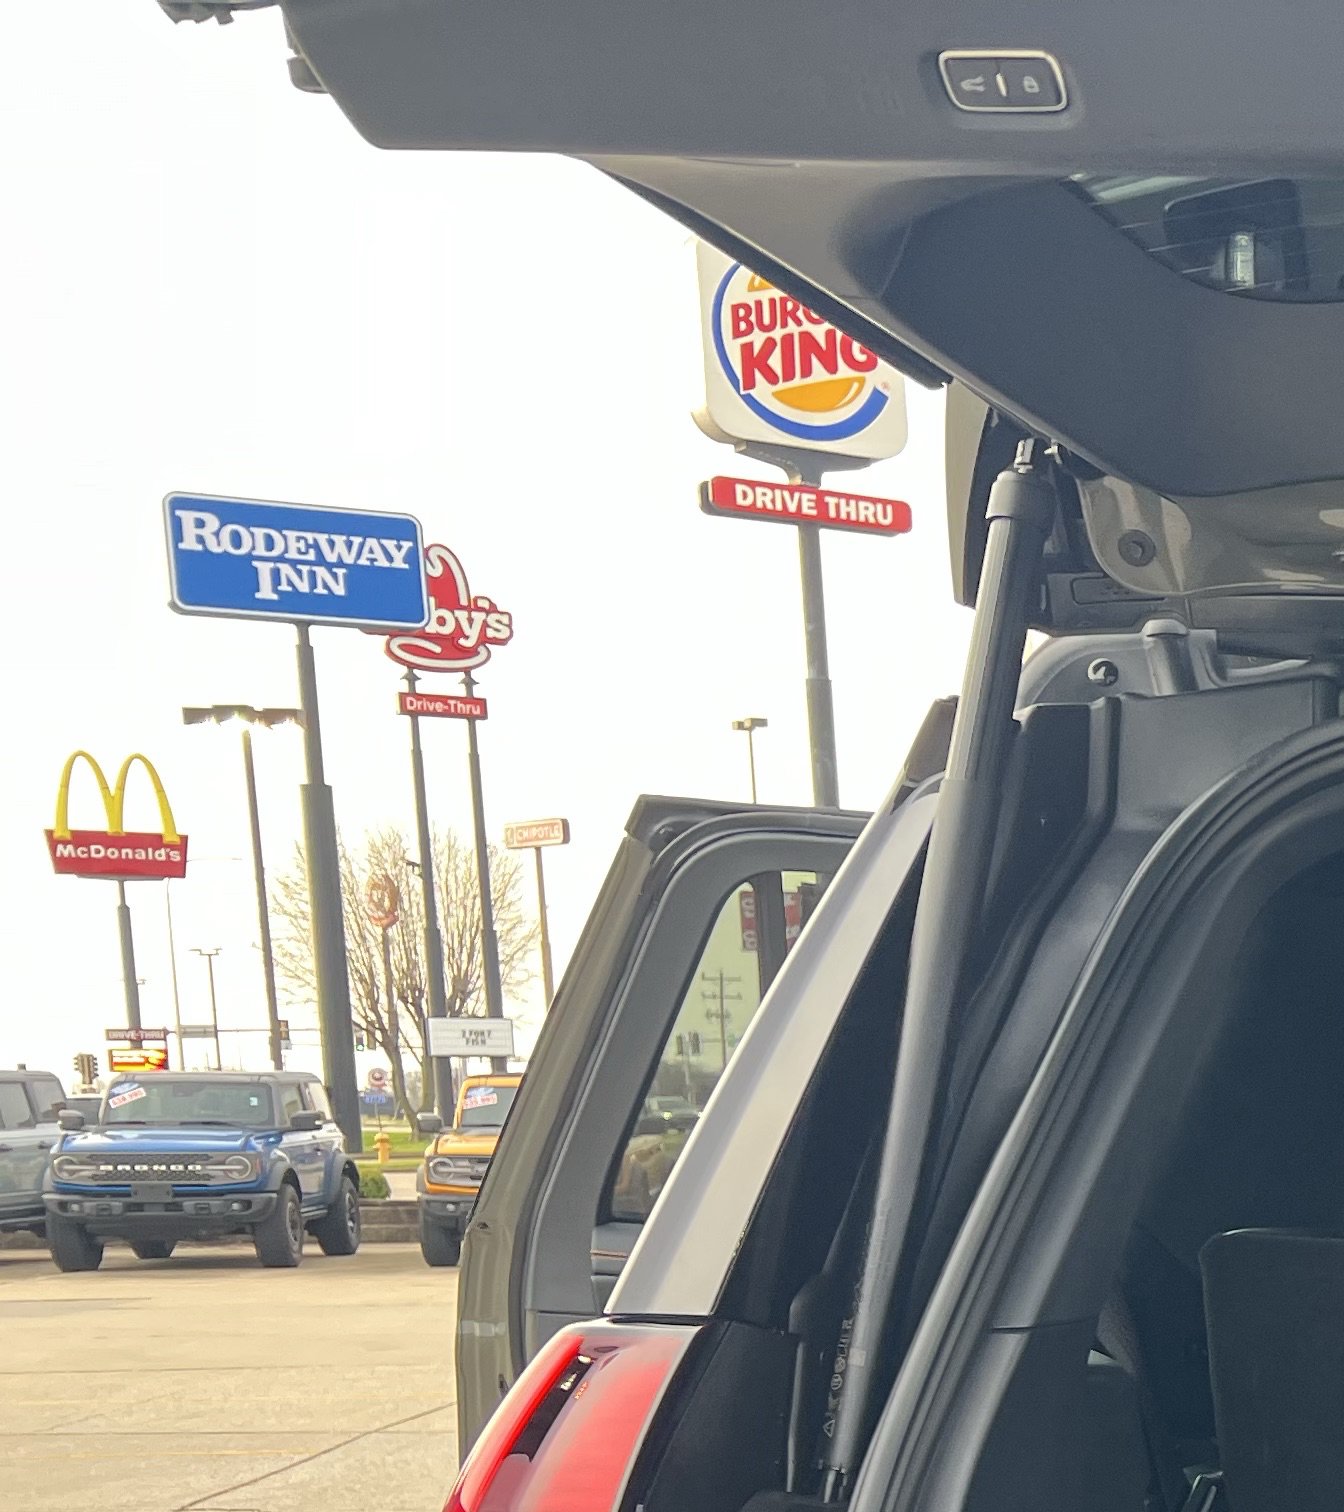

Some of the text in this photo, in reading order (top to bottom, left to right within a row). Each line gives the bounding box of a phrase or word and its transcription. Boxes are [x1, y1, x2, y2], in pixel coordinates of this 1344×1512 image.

[731, 296, 825, 339] BUR
[740, 328, 878, 391] KING
[735, 483, 893, 526] DRIVE THRU
[174, 509, 414, 570] RODEWAY
[251, 560, 348, 600] INN
[424, 596, 511, 647] by's
[406, 697, 481, 715] Drive-Thru
[55, 843, 181, 862] McDonald's
[516, 825, 560, 840] CHIPOTLE
